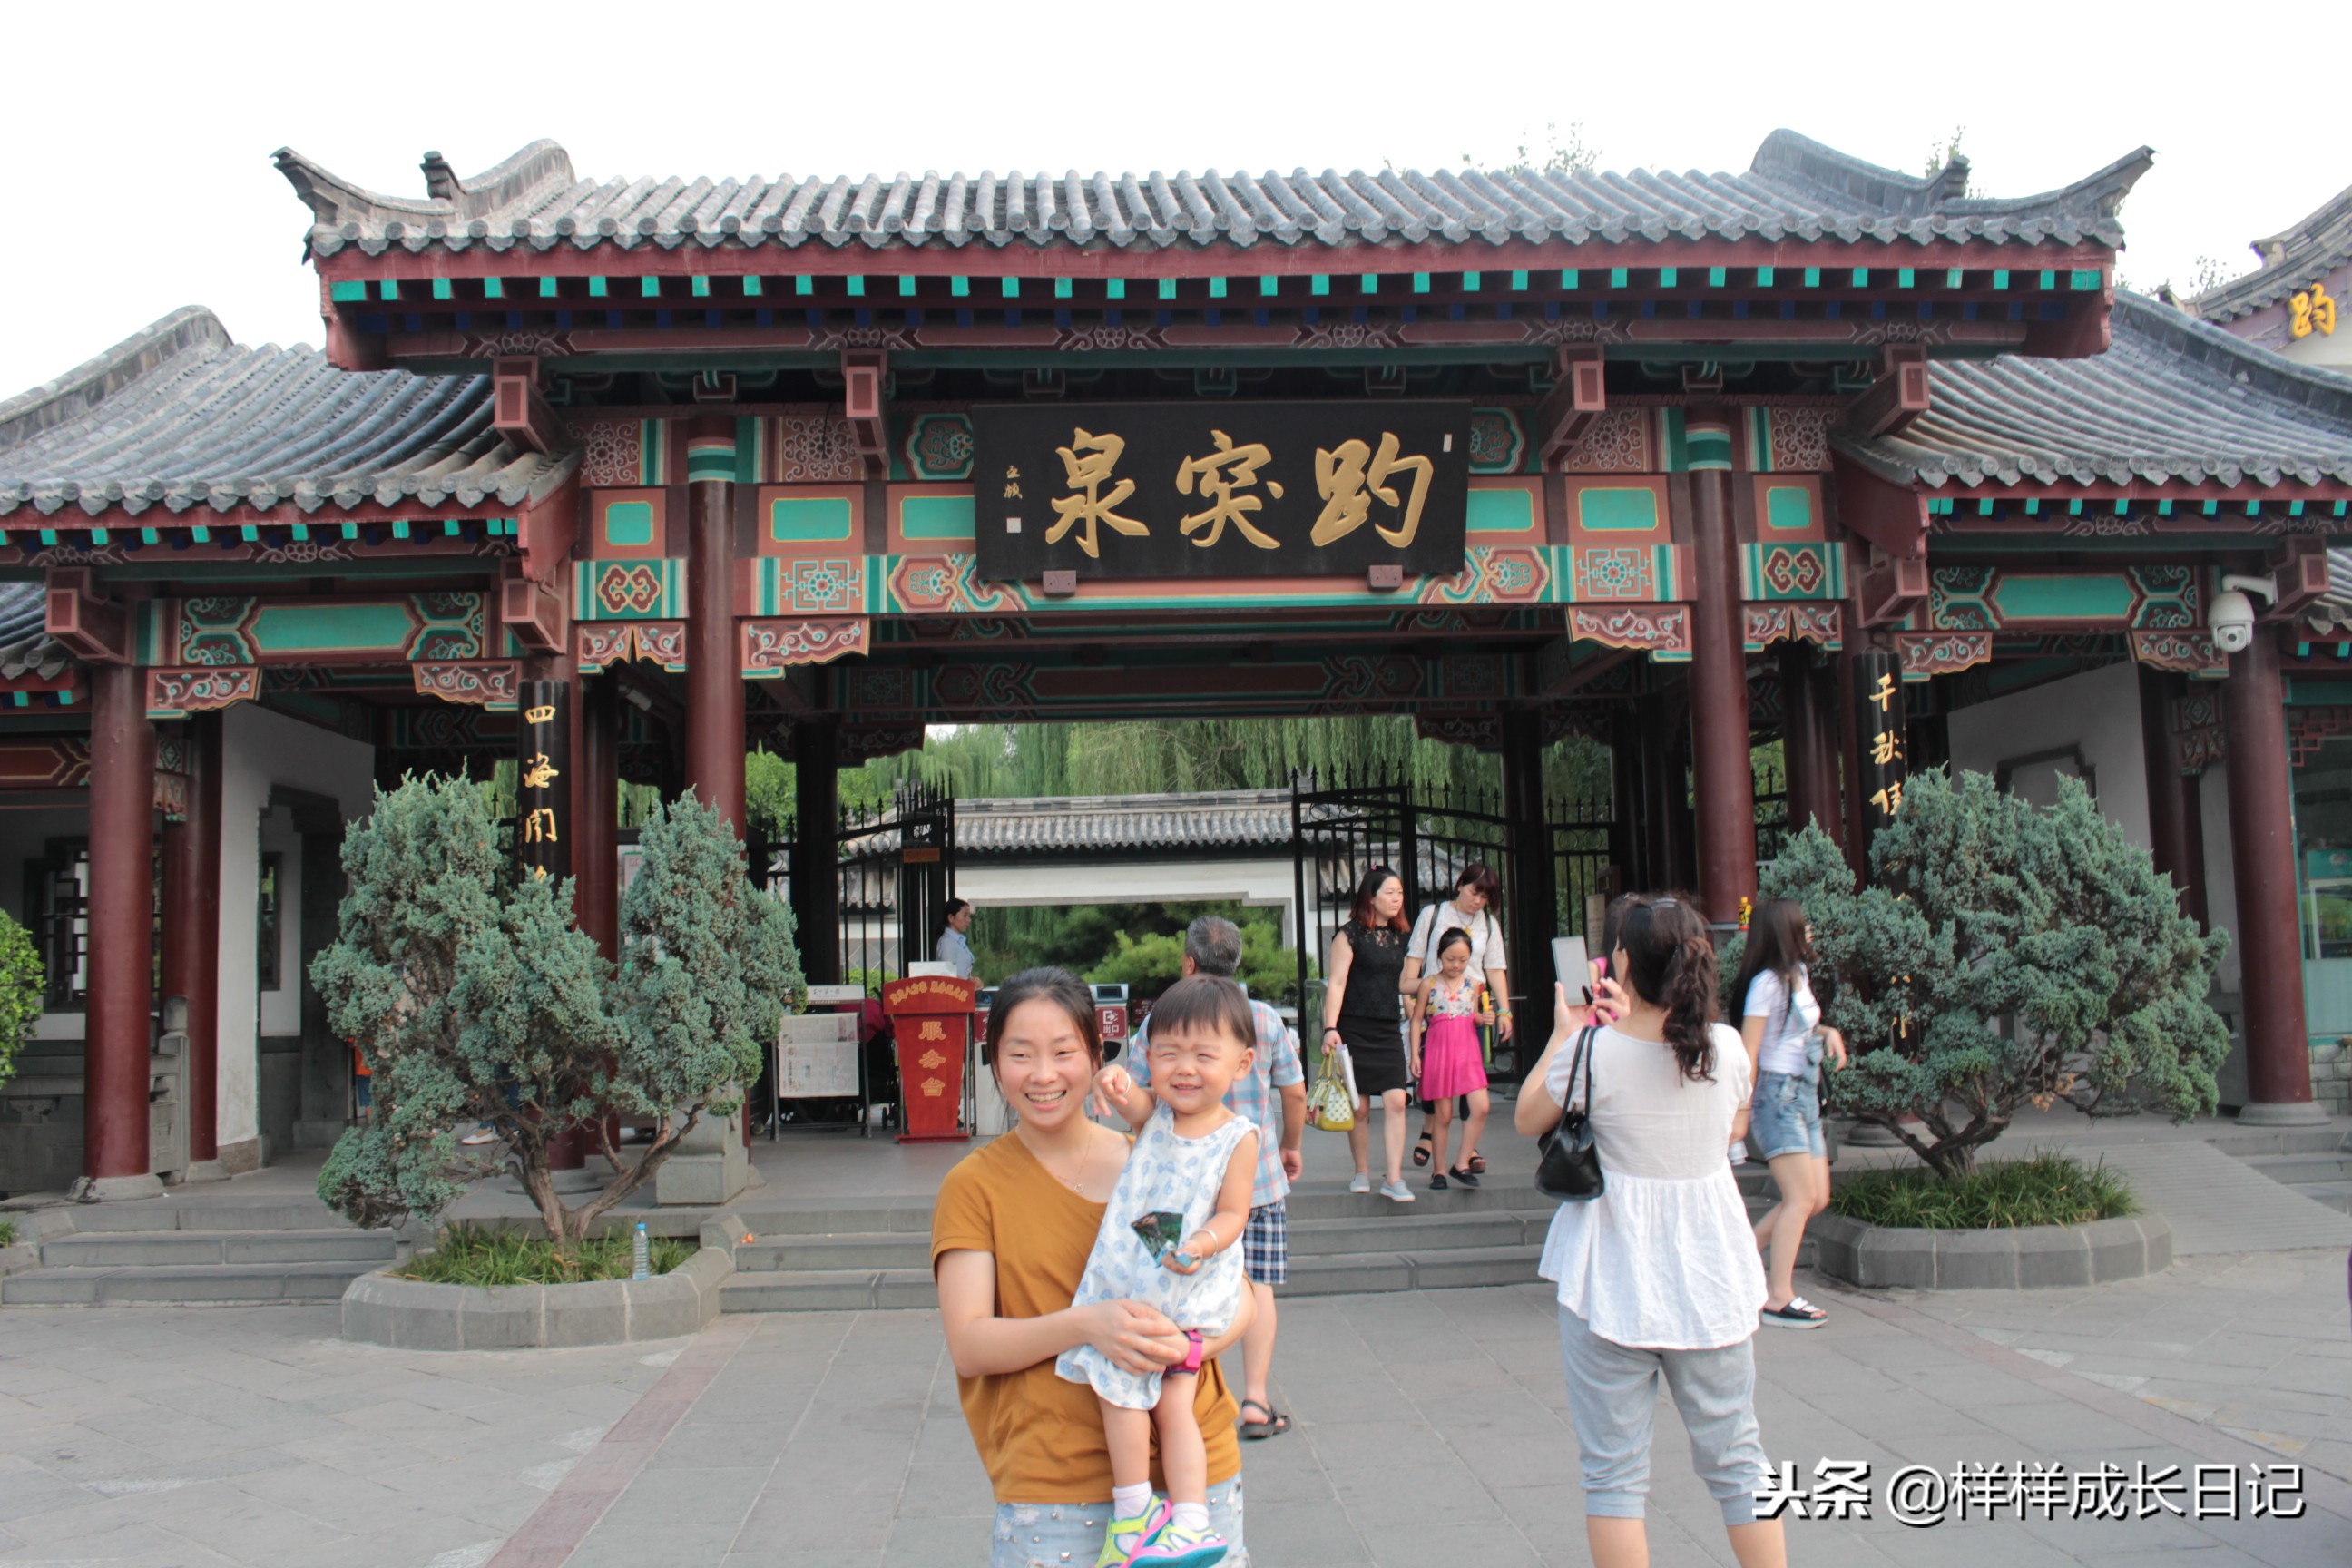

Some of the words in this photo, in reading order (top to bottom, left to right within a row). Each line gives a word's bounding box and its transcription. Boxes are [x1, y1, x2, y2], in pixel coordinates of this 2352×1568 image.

[2288, 282, 2337, 338] 趵
[1102, 1024, 1120, 1034] 出口
[918, 1021, 946, 1097] 服务台
